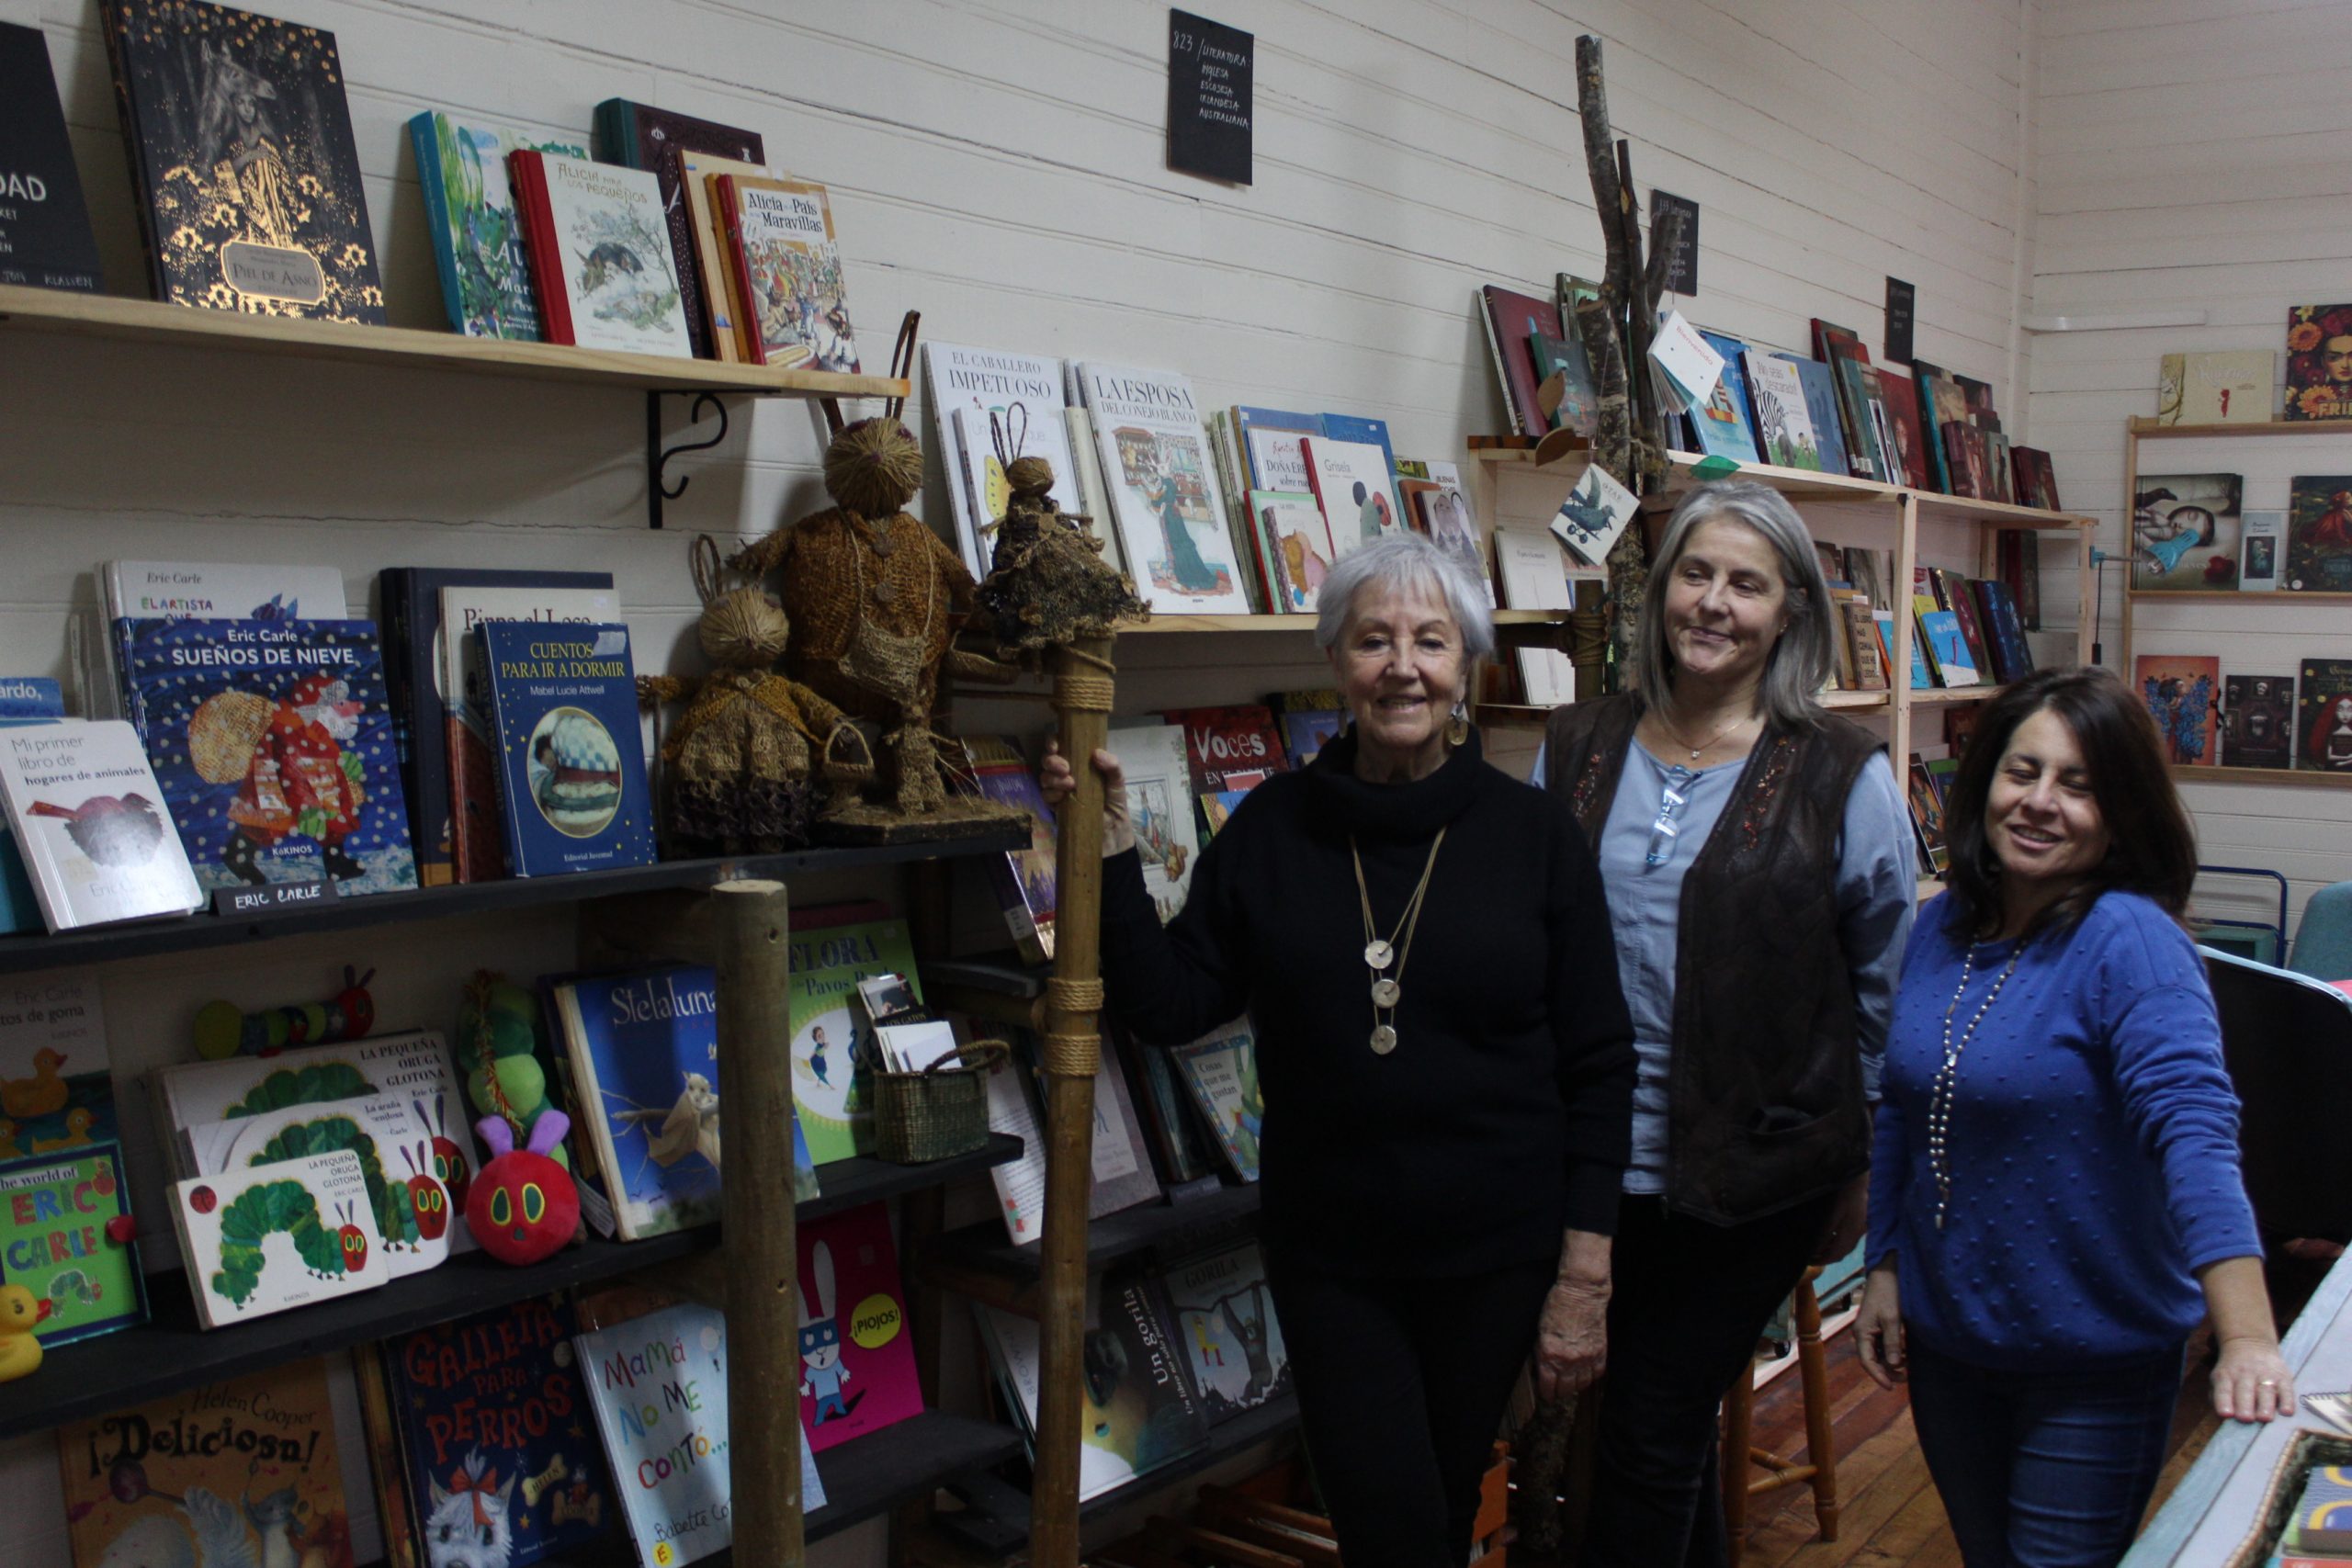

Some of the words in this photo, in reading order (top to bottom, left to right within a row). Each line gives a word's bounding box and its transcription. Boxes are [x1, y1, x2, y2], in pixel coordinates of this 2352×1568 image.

[1173, 29, 1193, 52] 823
[749, 192, 784, 212] Alicia
[761, 211, 823, 232] Maravillas
[952, 351, 969, 367] EL
[971, 354, 1041, 374] CABALLERO
[949, 368, 1051, 400] IMPETUOSO
[1095, 375, 1123, 400] LA
[1123, 378, 1193, 410] ESPOSA
[147, 570, 171, 584] Eric
[172, 571, 202, 585] Carle
[160, 597, 213, 612] ARTISTA
[227, 628, 256, 643] Eric
[259, 628, 299, 643] Carle
[171, 644, 259, 666] SUEÑOS
[264, 648, 292, 665] DE
[297, 647, 355, 665] NIEVE
[529, 642, 594, 660] CUENTOS
[501, 661, 539, 679] PARA
[541, 662, 557, 678] IR
[559, 662, 570, 678] A
[571, 661, 626, 678] DORMIR
[529, 684, 555, 696] Mabel
[556, 684, 578, 696] Lucie
[11, 738, 32, 753] Mi
[35, 737, 85, 754] primer
[1193, 726, 1266, 764] Voces
[17, 755, 55, 771] libro
[56, 753, 76, 766] de
[24, 773, 74, 786] hogares
[76, 770, 92, 781] de
[95, 766, 146, 780] animales
[234, 892, 270, 909] ERIC
[277, 885, 322, 903] CARLE
[788, 934, 882, 974] FLORA
[805, 976, 851, 997] Pavos
[28, 1008, 44, 1022] de
[49, 1005, 85, 1024] goma
[360, 1048, 379, 1061] LA
[379, 1038, 437, 1057] PEQUEÑA
[398, 1053, 442, 1069] ORUGA
[386, 1067, 446, 1087] GLOTONA
[309, 1160, 319, 1170] LA
[319, 1153, 357, 1168] PEQUEÑA
[330, 1164, 360, 1176] ORUGA
[21, 1169, 60, 1186] world
[63, 1166, 76, 1179] of
[322, 1173, 363, 1189] GLOTONA
[11, 1180, 98, 1227] ERIC
[6, 1225, 98, 1272] CARLE
[1185, 1257, 1240, 1290] GORILA
[853, 1309, 899, 1338] ¡PIOJOS!
[1123, 1288, 1155, 1347] gorila
[404, 1301, 565, 1390] GALLETA
[1148, 1351, 1170, 1386] Un
[473, 1366, 528, 1397] PARA
[190, 1383, 248, 1412] Helen
[251, 1390, 317, 1430] Cooper
[425, 1373, 573, 1466] PERROS
[89, 1409, 320, 1479] ¡Deliciosa!
[654, 1507, 710, 1543] Babette
